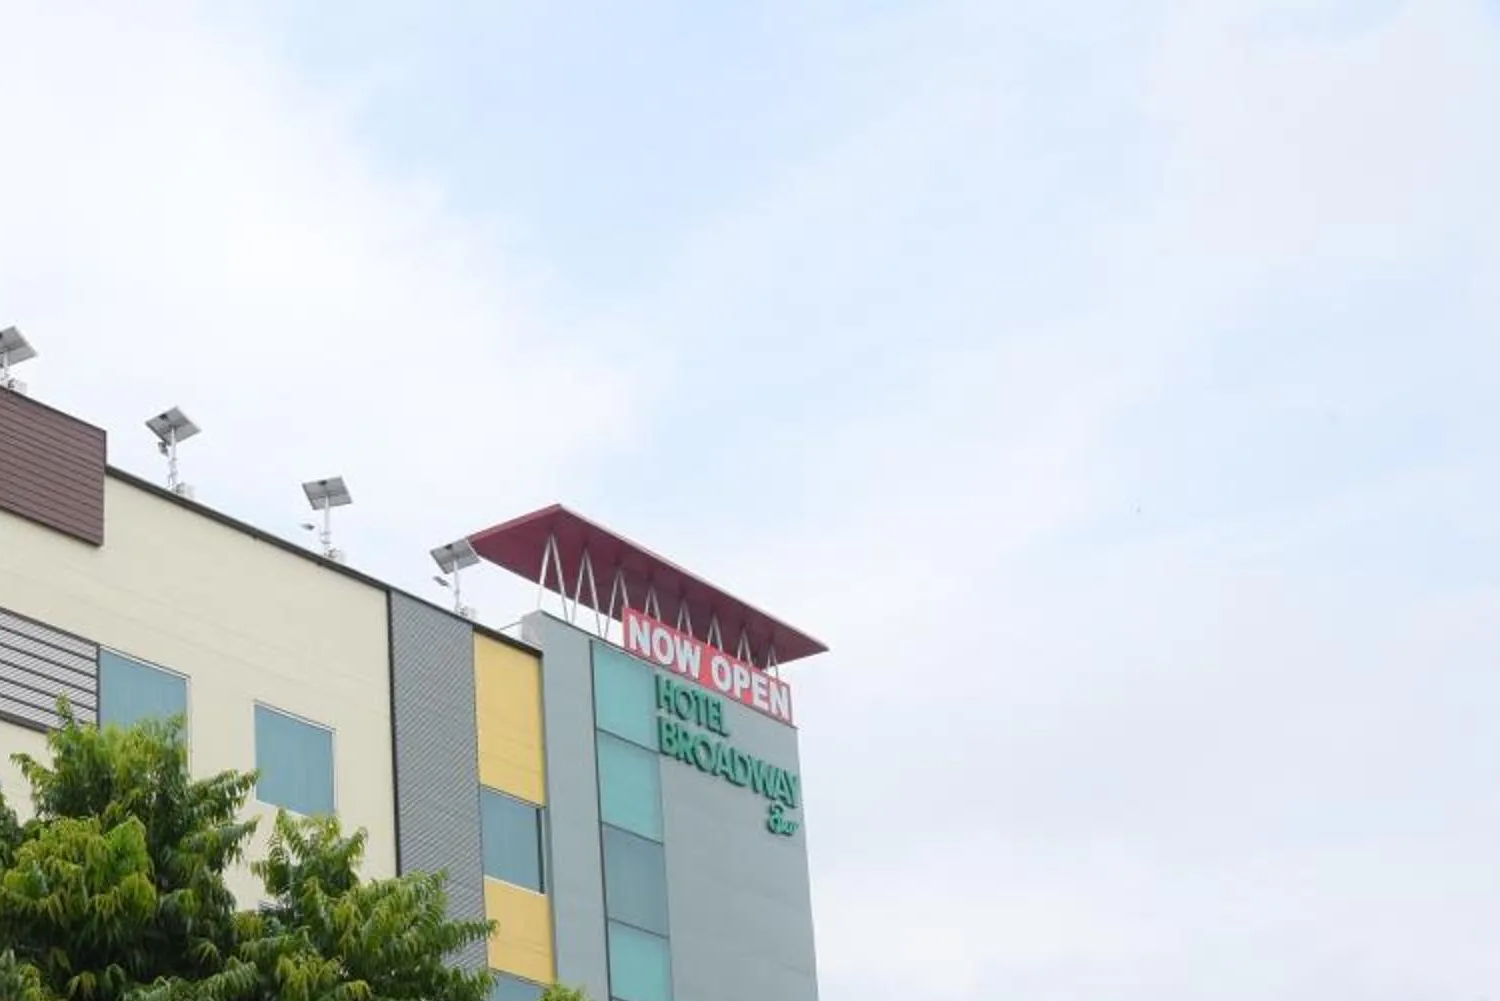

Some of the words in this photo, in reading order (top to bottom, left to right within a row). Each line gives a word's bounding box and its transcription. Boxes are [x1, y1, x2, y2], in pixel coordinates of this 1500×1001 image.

[629, 615, 702, 678] NOW
[711, 655, 790, 720] OPEN
[655, 674, 729, 737] HOTEL
[658, 717, 798, 809] BROADWAY
